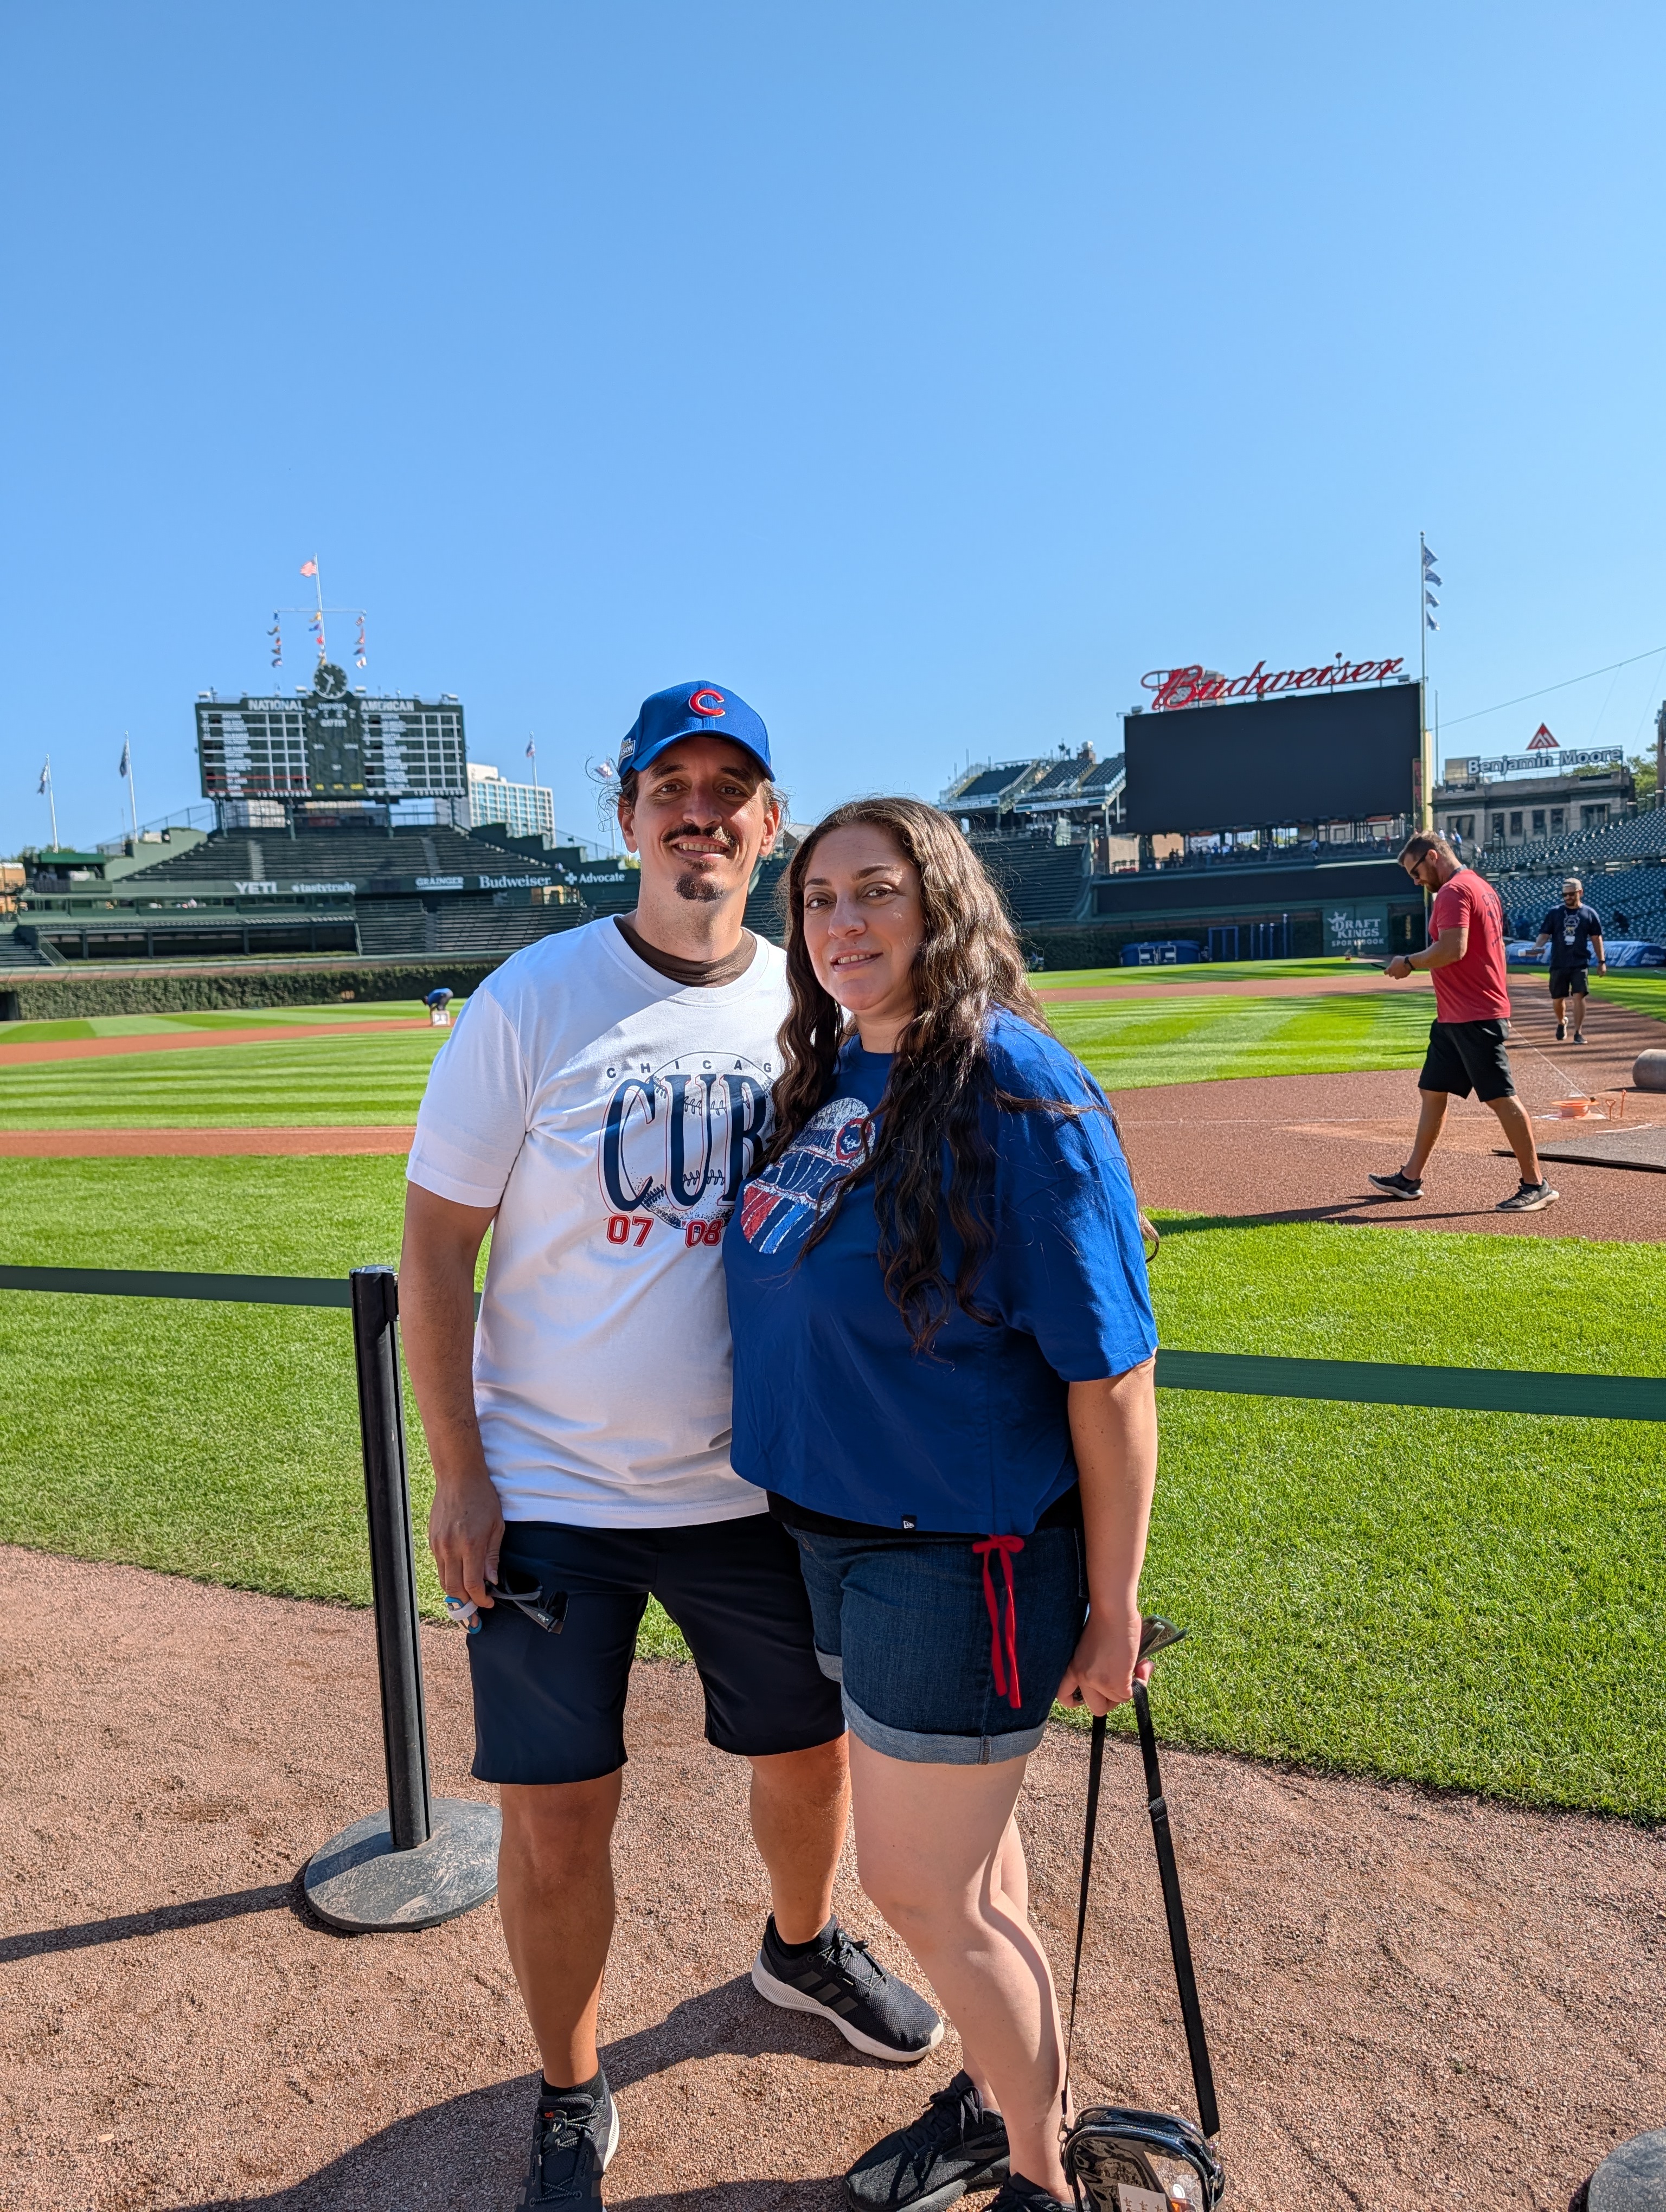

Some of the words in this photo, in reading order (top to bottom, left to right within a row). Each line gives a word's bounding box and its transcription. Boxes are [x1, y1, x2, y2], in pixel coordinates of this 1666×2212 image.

[1140, 652, 1404, 711] Budweiser
[248, 699, 305, 711] NATIONAL
[361, 700, 414, 711] AMERICAN
[689, 689, 725, 717] C
[1468, 753, 1554, 776] Benjamin
[1559, 749, 1622, 766] Moore
[415, 876, 464, 886] GRAINGER
[579, 872, 625, 884] Advocate
[234, 881, 278, 895] YETI
[1331, 918, 1381, 932] DRAFT
[1337, 928, 1380, 938] KINGS
[1331, 938, 1385, 947] SPORBOOK
[606, 1060, 772, 1079] CHICAG
[598, 1073, 766, 1214] CUB
